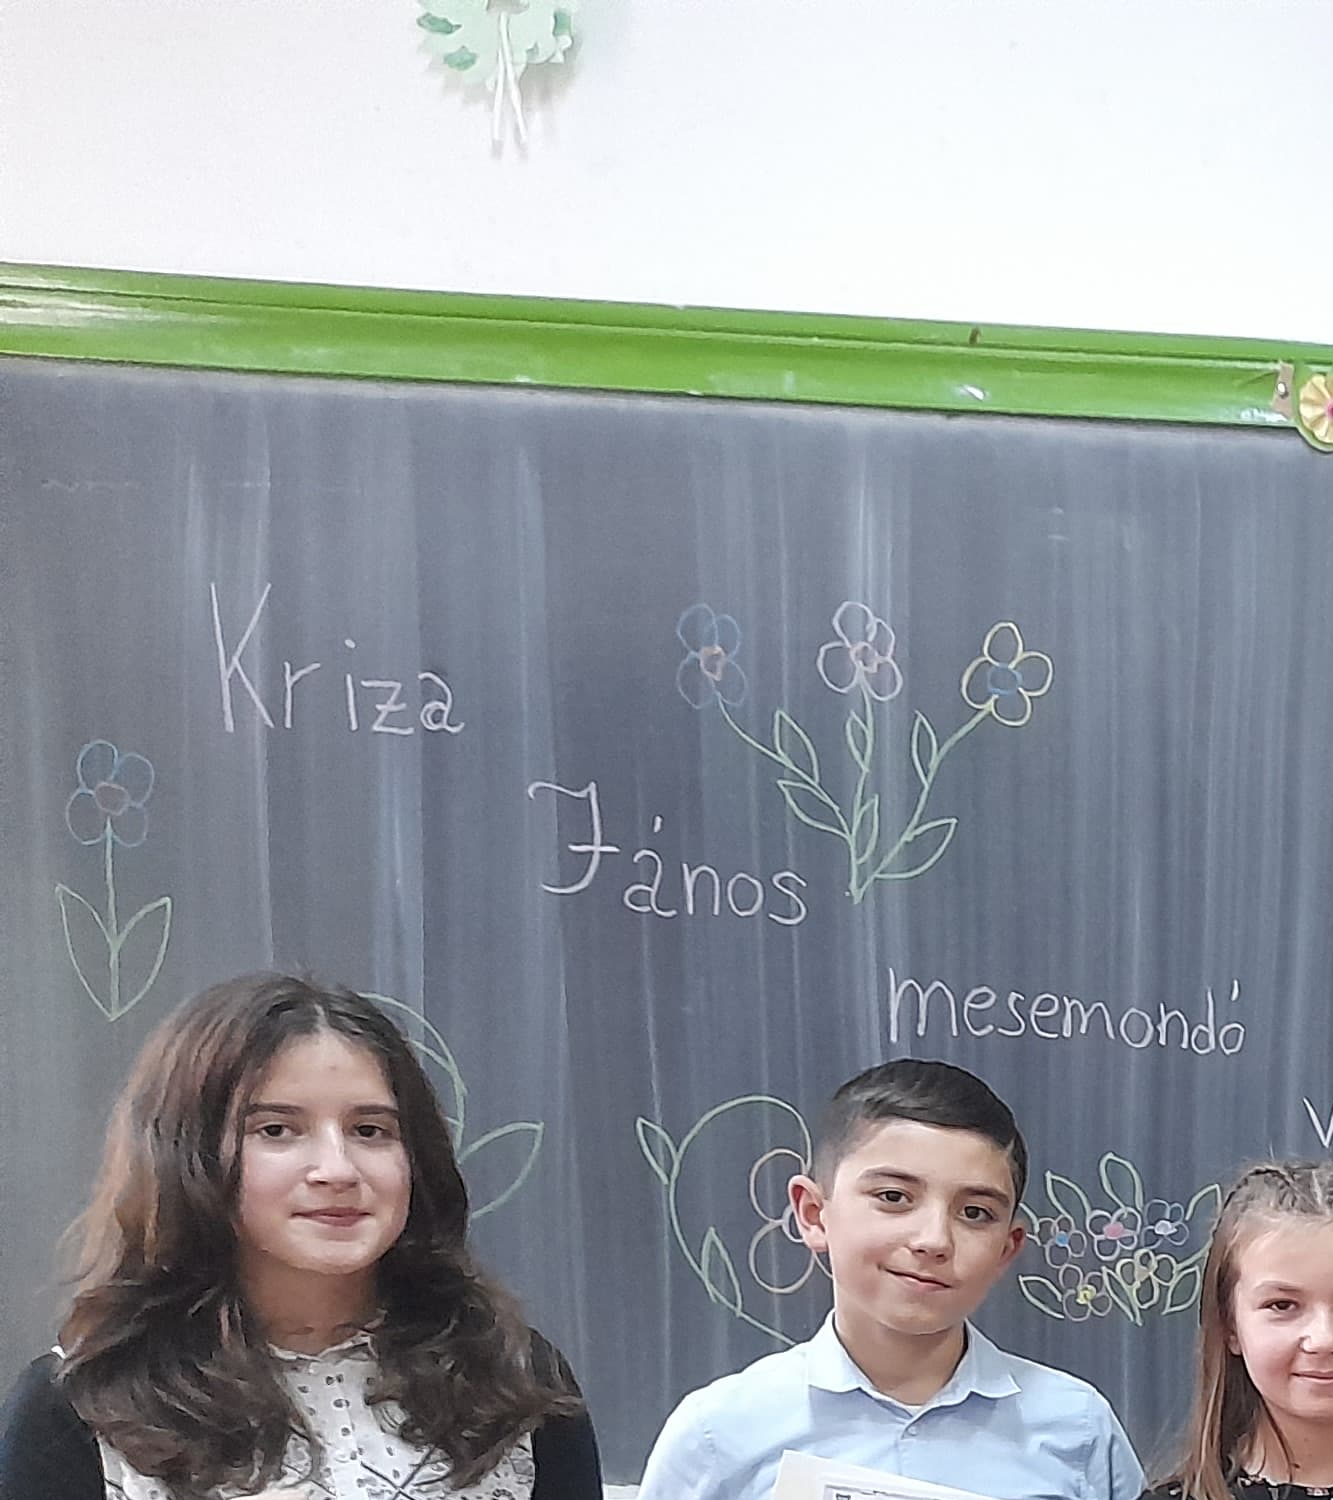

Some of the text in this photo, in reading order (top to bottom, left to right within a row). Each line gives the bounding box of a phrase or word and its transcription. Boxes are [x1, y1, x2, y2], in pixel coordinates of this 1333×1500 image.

[211, 583, 465, 734] Kriza
[528, 780, 807, 926] János
[888, 967, 1247, 1055] mesemondó
